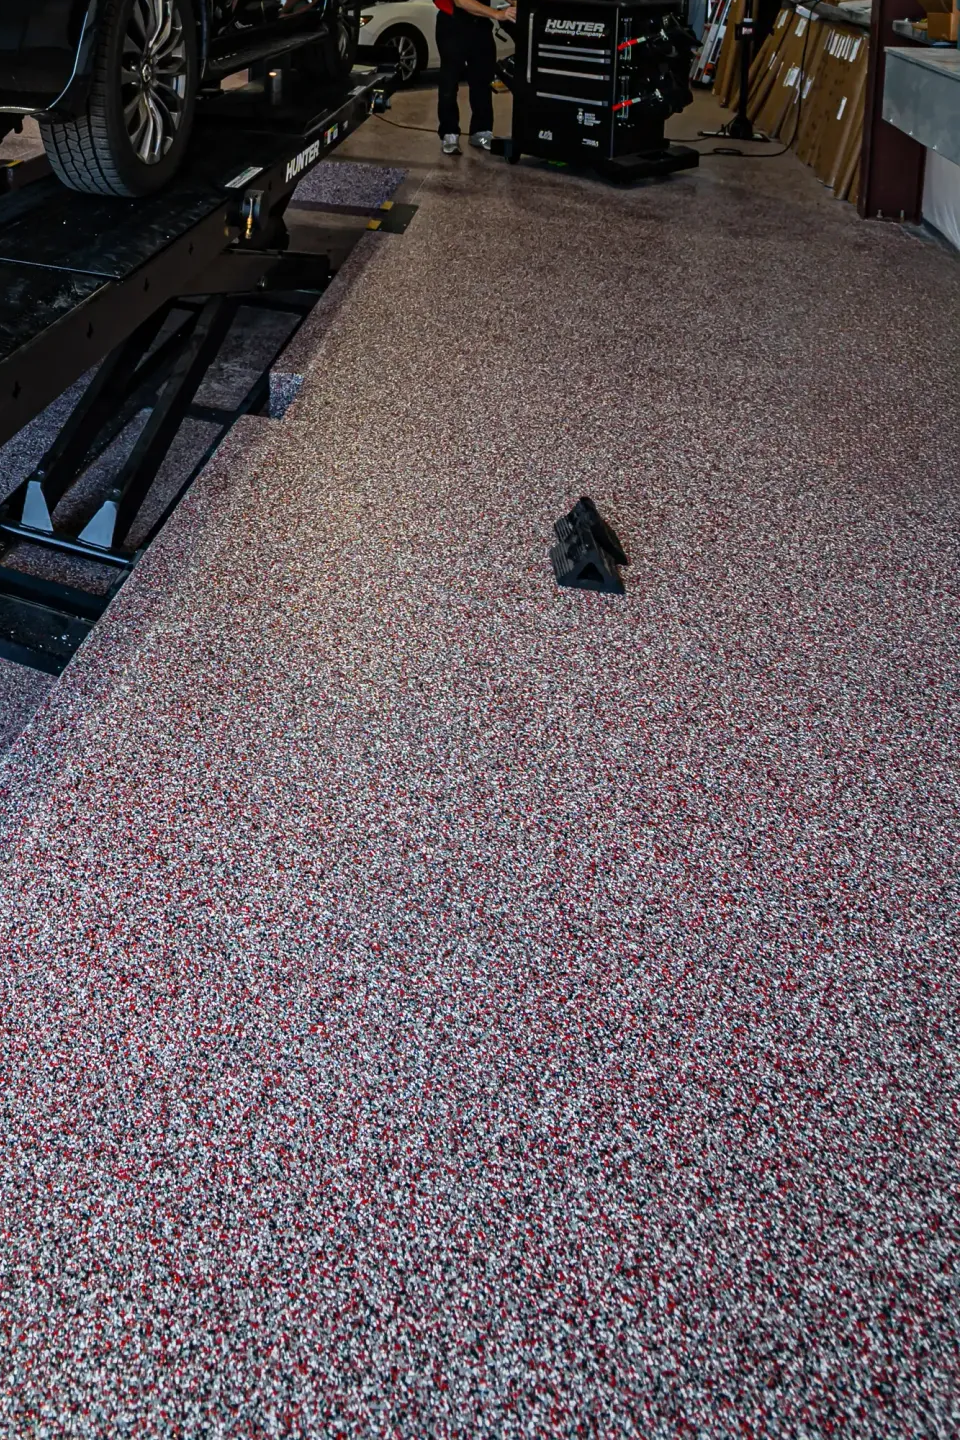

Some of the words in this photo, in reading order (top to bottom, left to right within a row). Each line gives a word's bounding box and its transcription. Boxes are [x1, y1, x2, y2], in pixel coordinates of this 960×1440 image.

[544, 27, 576, 37] Engineering
[575, 30, 604, 39] Company
[545, 18, 605, 33] HUNTER
[285, 139, 320, 184] HUNTER
